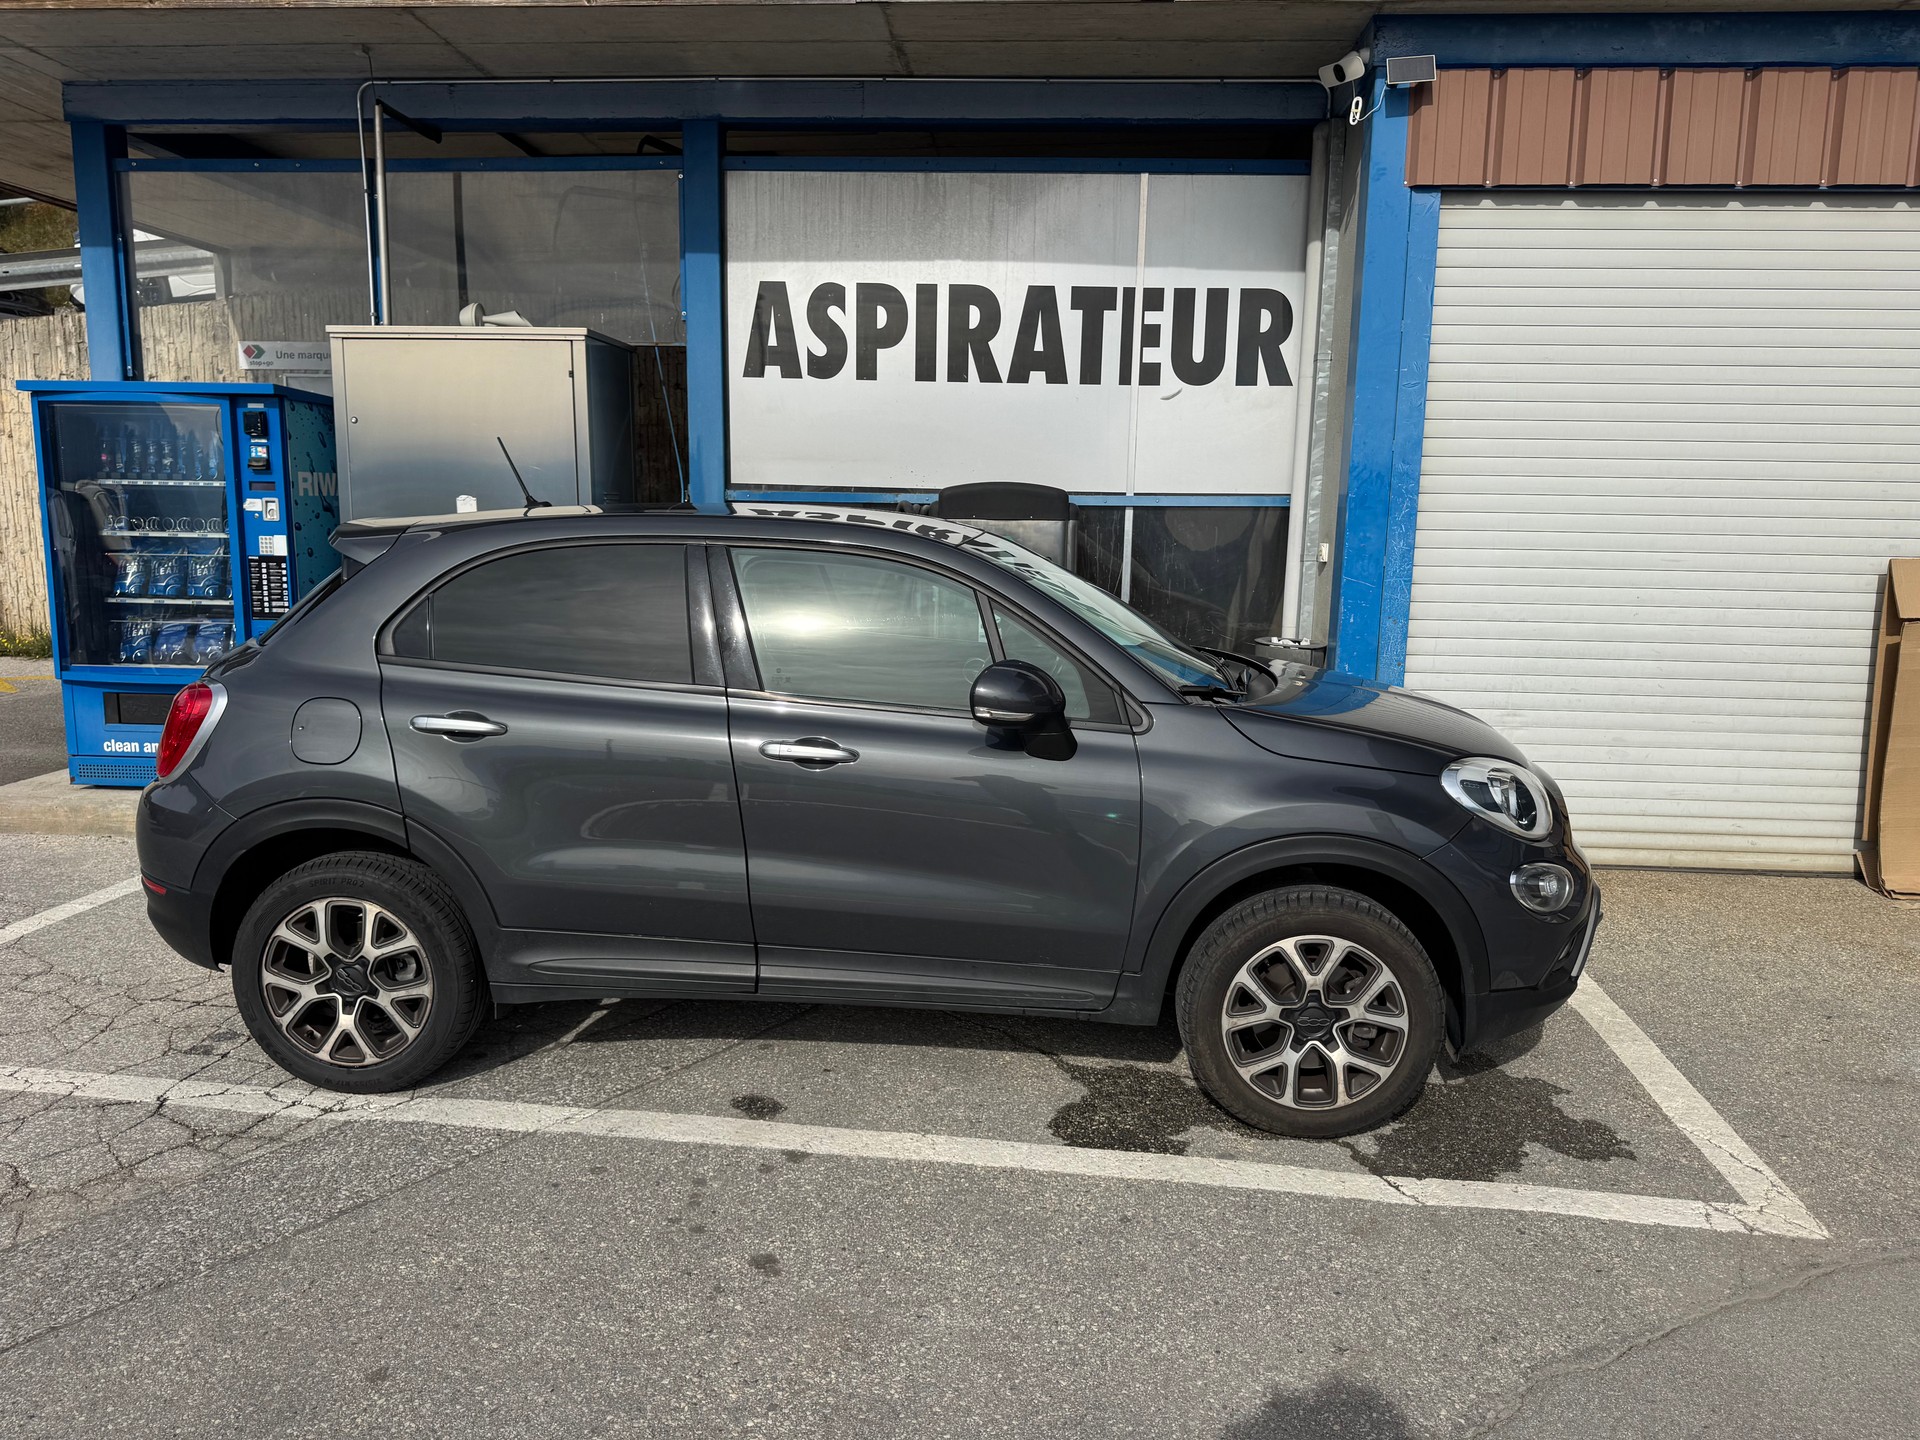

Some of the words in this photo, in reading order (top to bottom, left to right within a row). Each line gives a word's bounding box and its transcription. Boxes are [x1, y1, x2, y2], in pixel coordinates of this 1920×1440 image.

[742, 281, 1294, 386] ASPIRATEUR
[275, 350, 295, 359] Une
[298, 351, 331, 361] marqu
[298, 471, 339, 497] RIW
[103, 739, 140, 752] clean
[143, 742, 159, 752] an
[309, 877, 337, 888] SPIRIT
[341, 878, 358, 887] PRO
